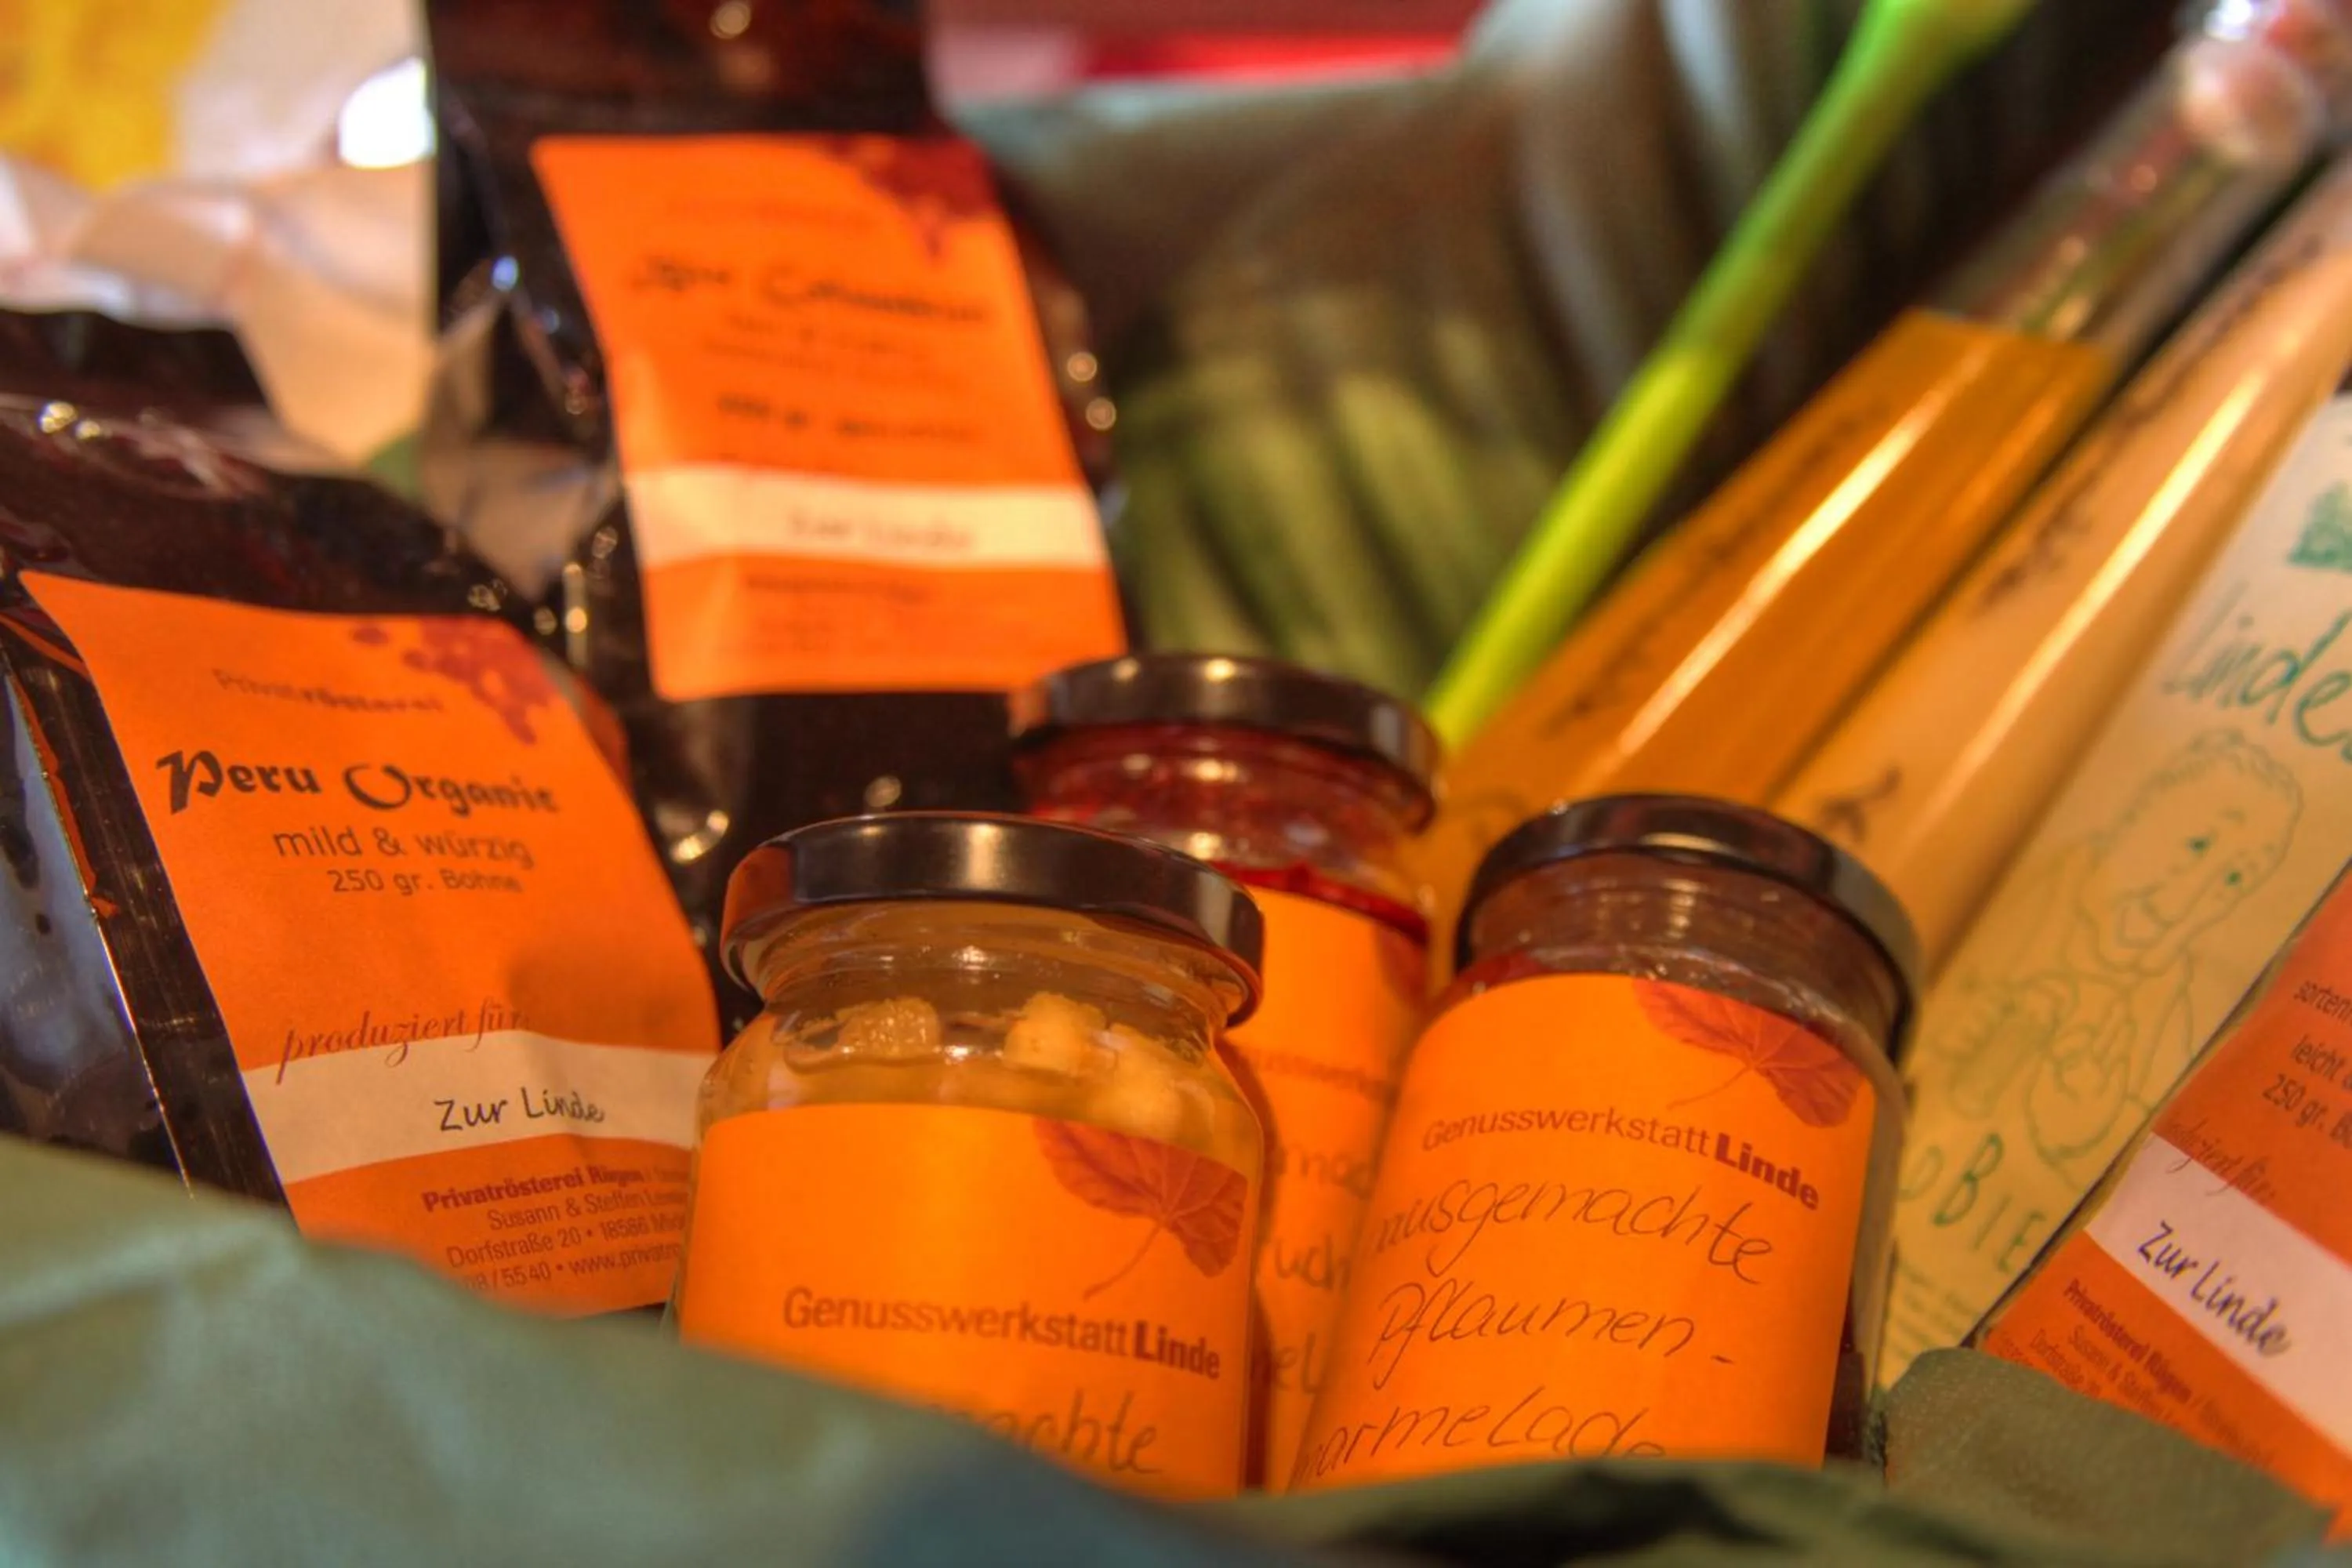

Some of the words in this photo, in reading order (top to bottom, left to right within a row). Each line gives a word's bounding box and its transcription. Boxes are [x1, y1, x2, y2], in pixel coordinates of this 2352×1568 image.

[154, 749, 323, 815] Peru
[273, 825, 363, 857] mild
[372, 826, 408, 857] &
[415, 829, 535, 870] würzig
[326, 869, 384, 892] 250
[393, 873, 434, 896] gr.
[275, 1008, 467, 1085] produziert
[434, 1098, 508, 1131] Zur
[521, 1086, 605, 1124] Linde
[421, 1167, 584, 1213] Privatrösterei
[486, 1204, 561, 1231] Susann
[565, 1197, 582, 1218] &
[1374, 1178, 1773, 1285] ausgemachte
[446, 1232, 554, 1269] Dorfstraße
[557, 1226, 582, 1248] 20
[2138, 1220, 2198, 1279] Zur
[2190, 1259, 2292, 1359] Linde
